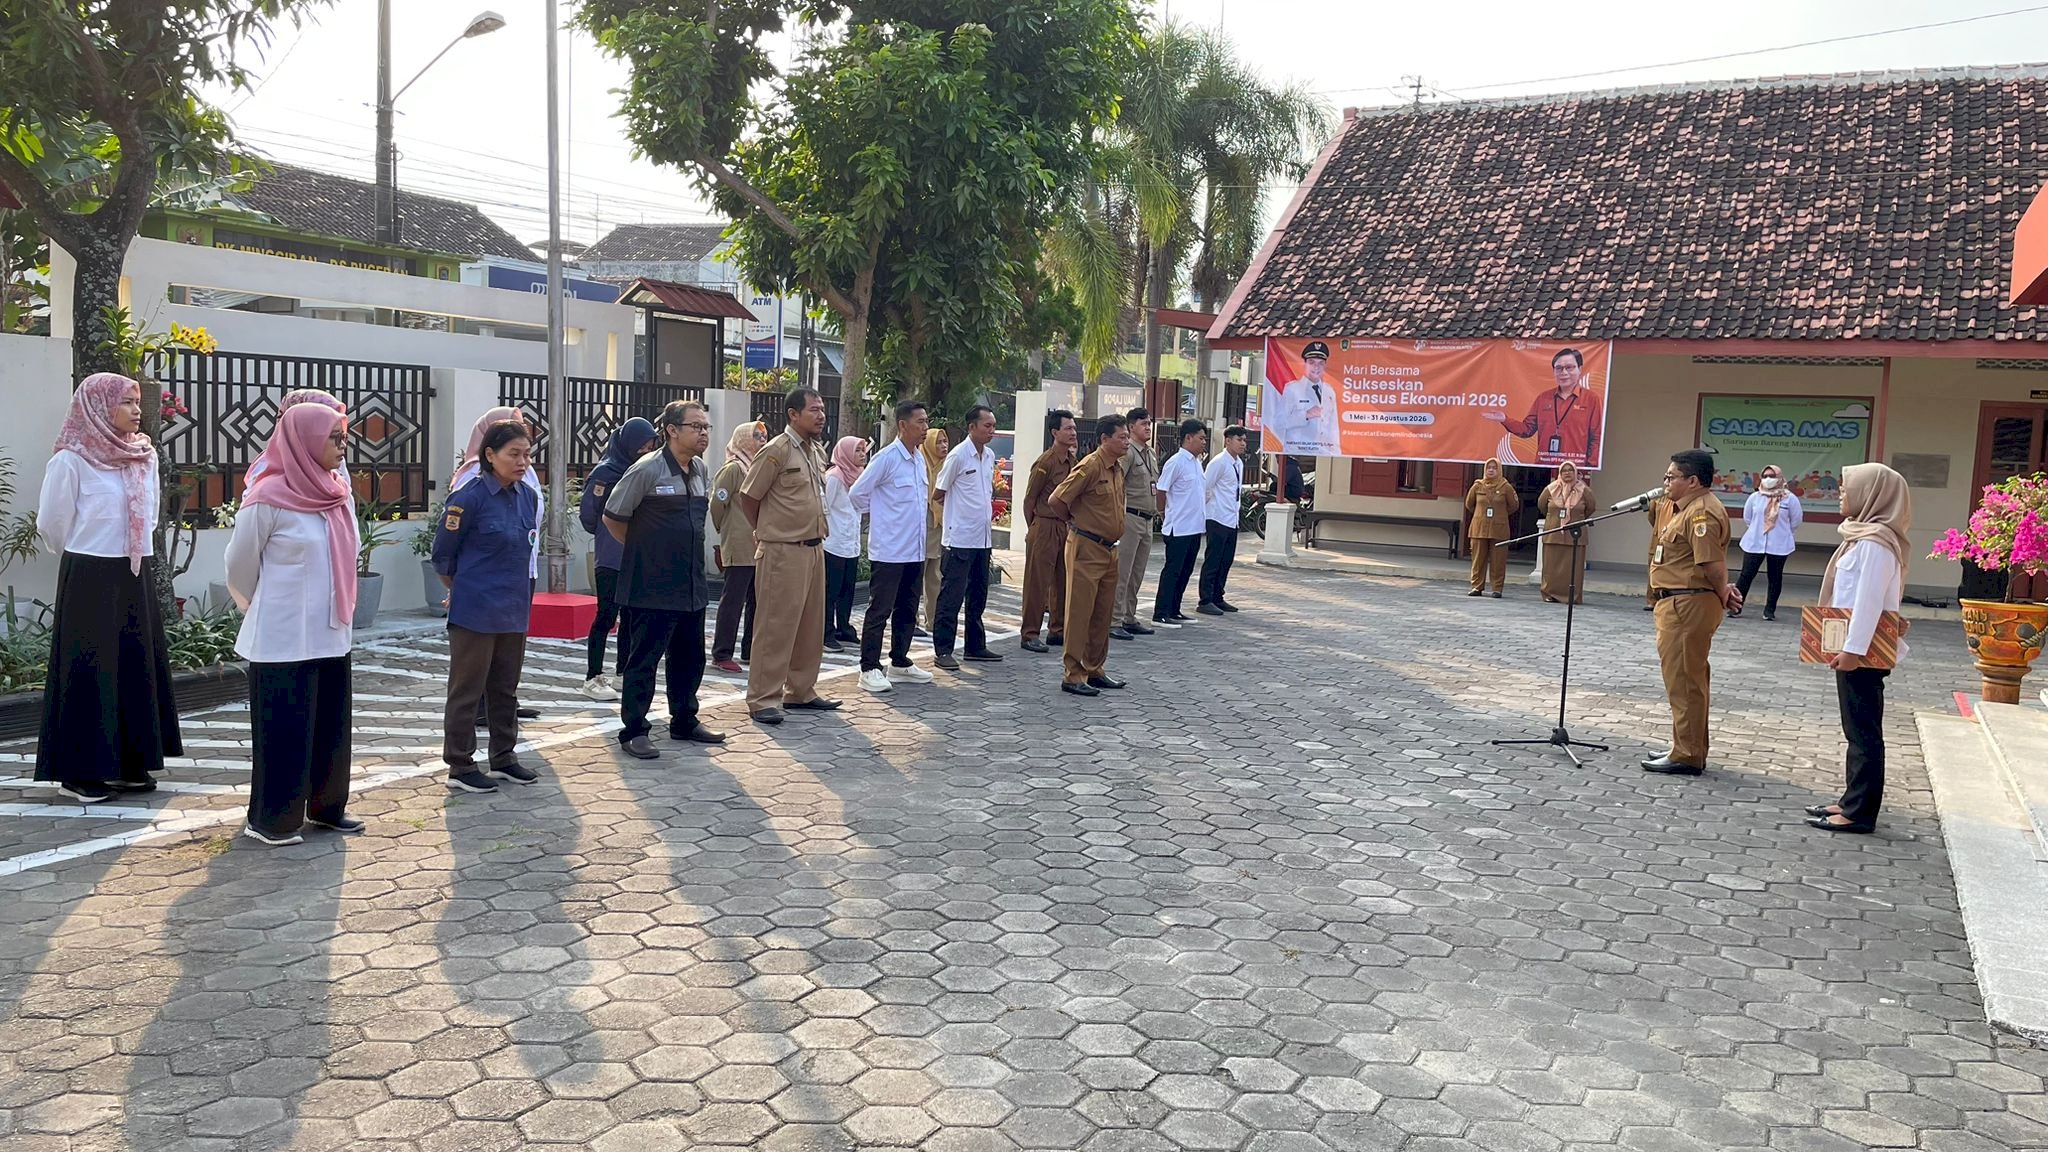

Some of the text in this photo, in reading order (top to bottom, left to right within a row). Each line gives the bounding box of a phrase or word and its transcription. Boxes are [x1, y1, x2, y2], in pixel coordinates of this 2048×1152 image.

[751, 298, 772, 306] ATM
[1343, 365, 1420, 376] Mari Bersama
[1343, 378, 1424, 391] Sukseskan
[1342, 391, 1508, 407] Sensus Ekonomi 2026
[1379, 414, 1409, 422] Agustus
[1709, 418, 1860, 439] SABAR MAS
[1761, 439, 1790, 448] Bareng
